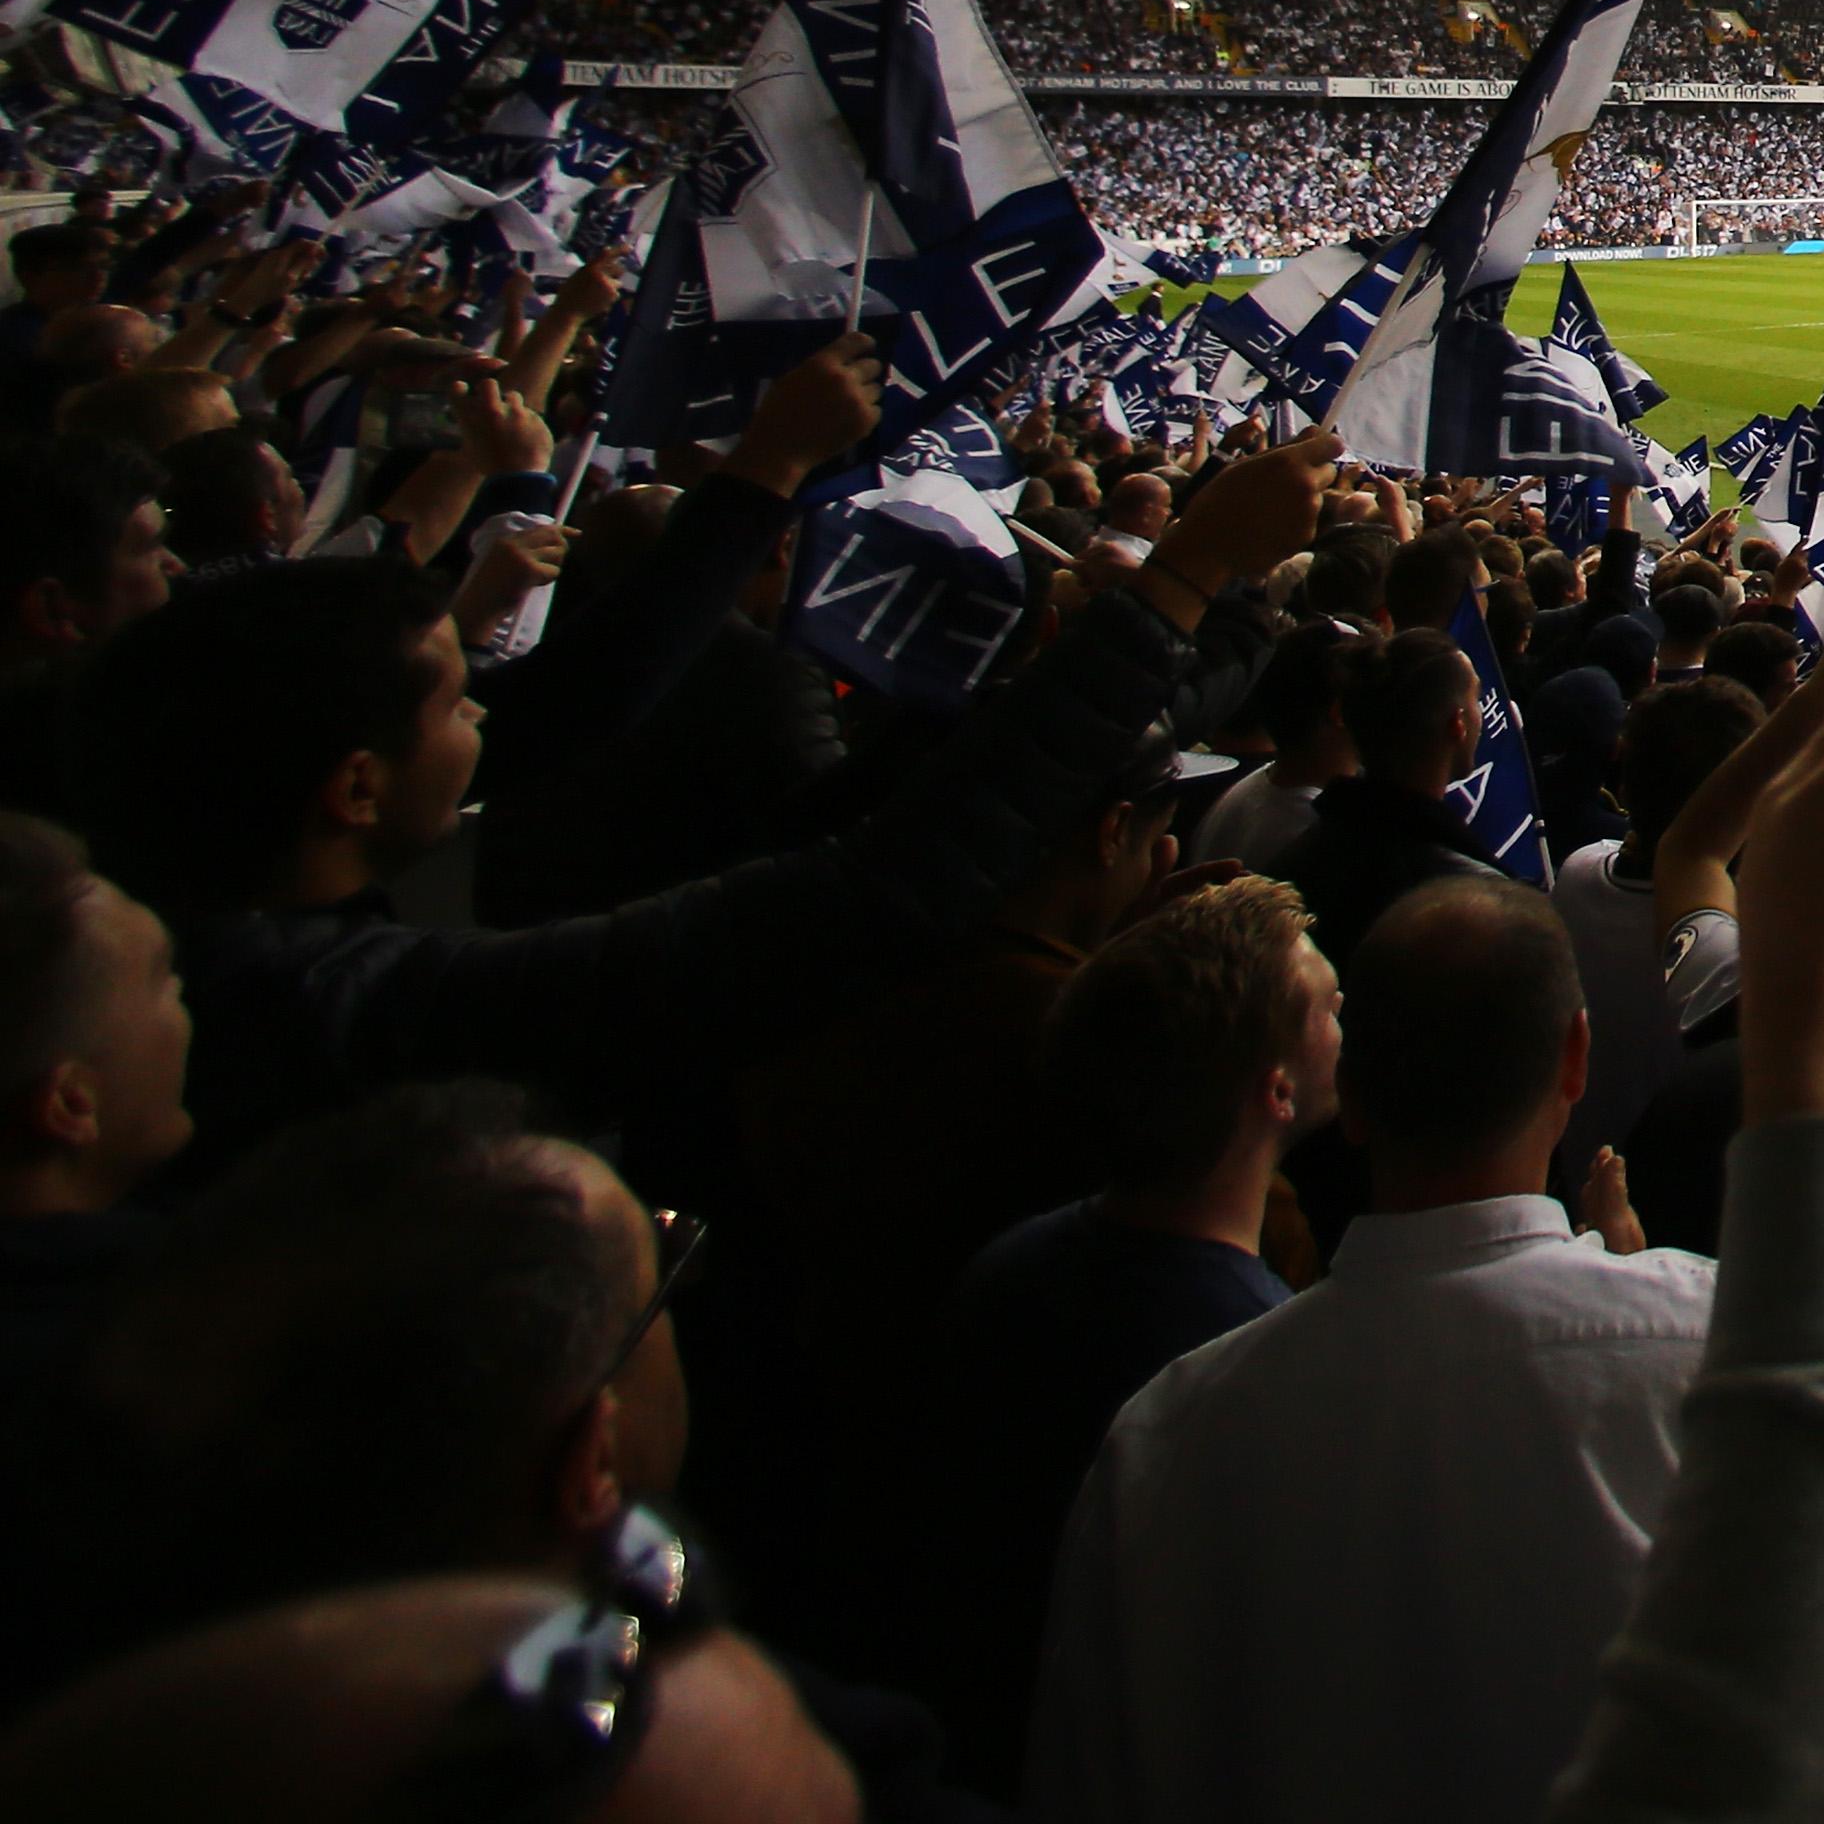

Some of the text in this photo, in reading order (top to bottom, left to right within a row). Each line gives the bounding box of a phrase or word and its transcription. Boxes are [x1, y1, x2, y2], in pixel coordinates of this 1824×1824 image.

[1174, 79, 1204, 90] AND
[1217, 79, 1252, 91] LOVE
[1256, 79, 1281, 91] THE
[1369, 81, 1400, 95] THE
[1405, 80, 1452, 95] GAME
[1457, 81, 1471, 95] IS
[1646, 85, 1730, 100] OTTENHAM
[1554, 249, 1643, 263] DOWNLOAD NOW!
